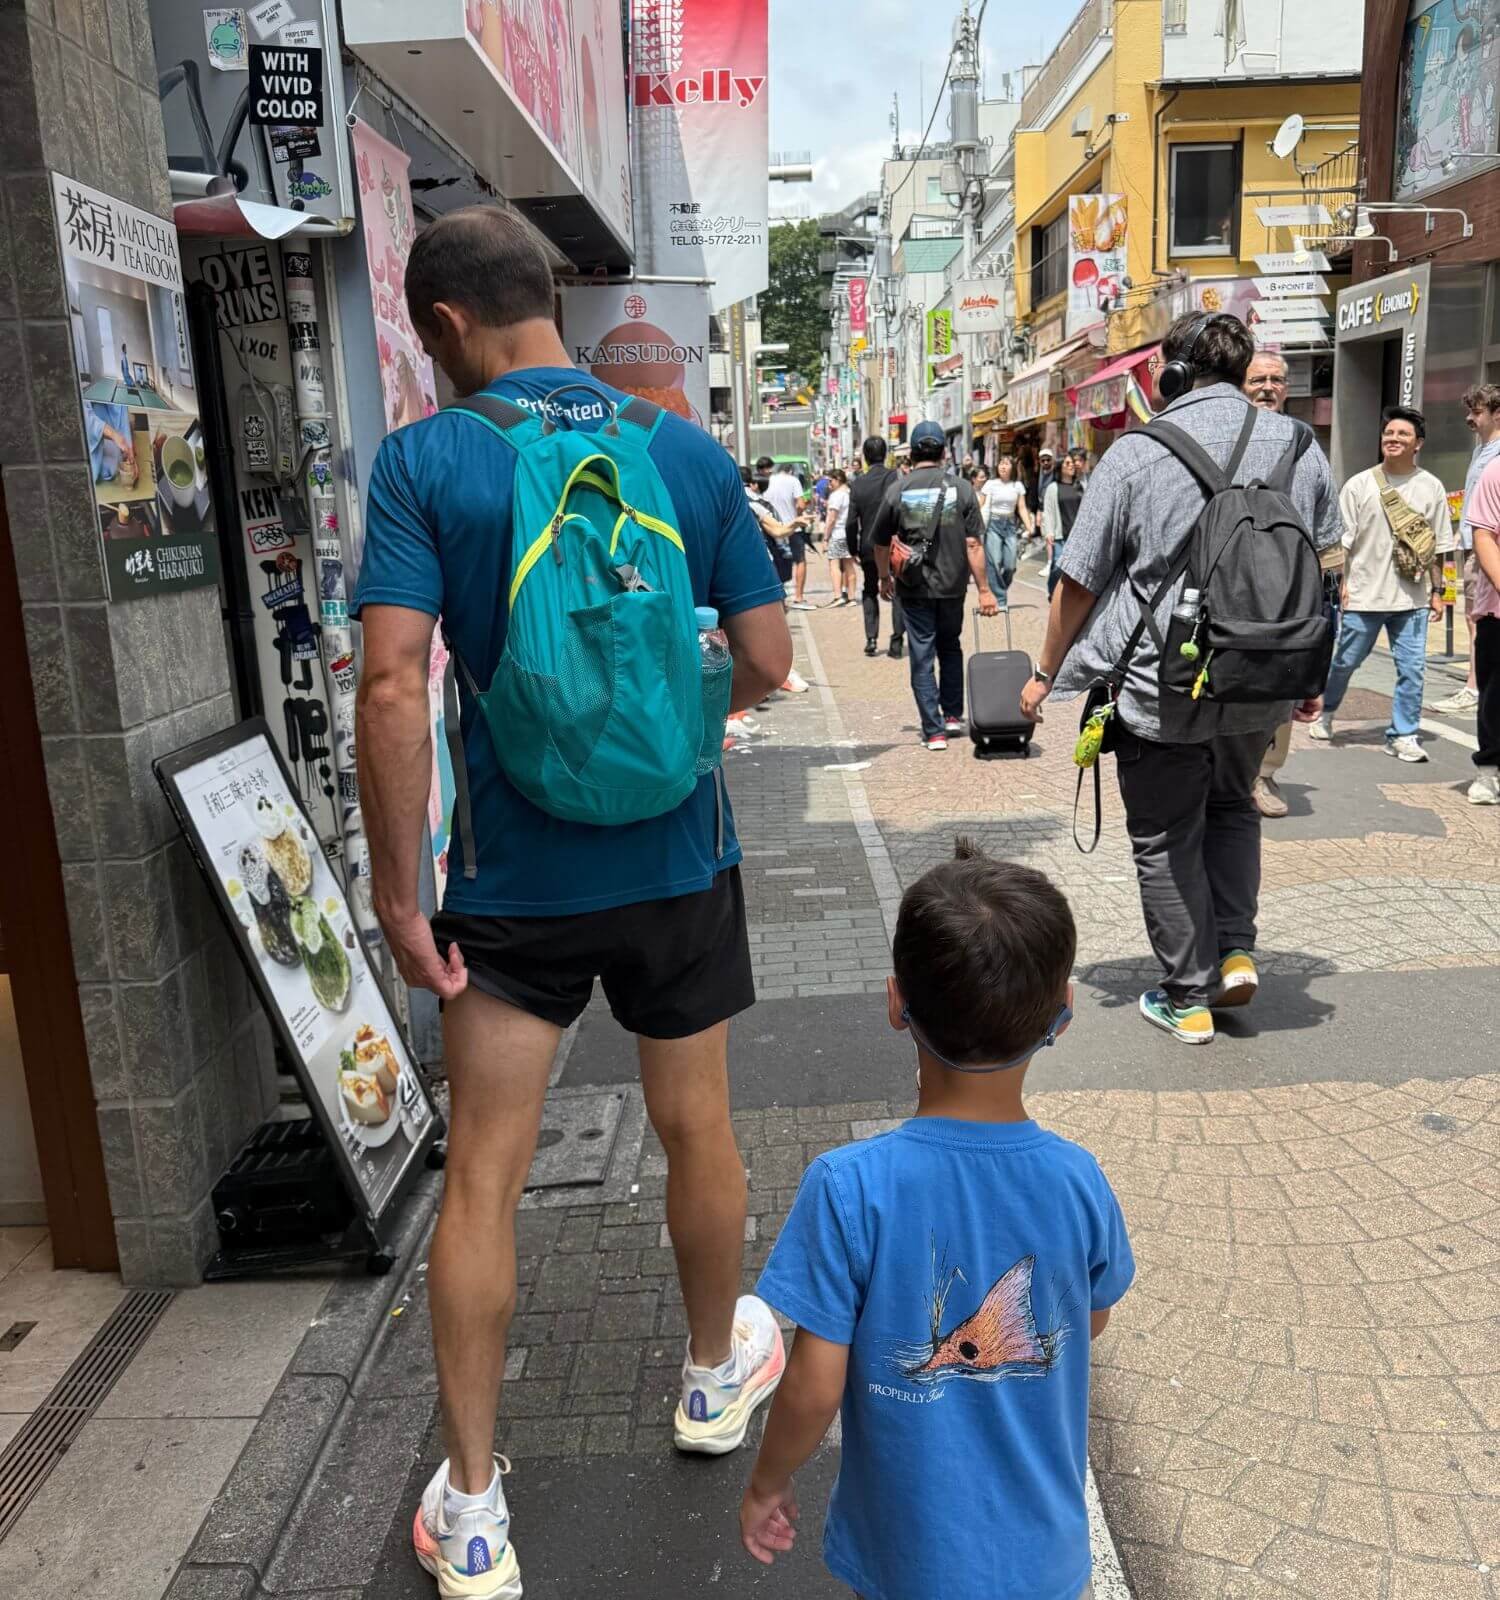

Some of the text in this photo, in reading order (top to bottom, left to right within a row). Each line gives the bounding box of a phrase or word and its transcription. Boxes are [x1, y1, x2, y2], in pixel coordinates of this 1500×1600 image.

[261, 52, 309, 73] WITH
[261, 75, 313, 95] VIVID
[634, 68, 766, 108] Kelly
[256, 99, 317, 119] COLOR
[669, 203, 701, 214] 不動産
[60, 186, 116, 262] 茶房
[117, 211, 177, 259] MATCHA
[120, 243, 180, 285] TEA ROOM
[1338, 291, 1412, 331] CAFE LEMONICA
[576, 345, 705, 364] KATSUDON
[1403, 332, 1416, 407] UNI DON
[156, 544, 203, 563] CHIKUSUIAN
[158, 559, 204, 580] HARAJUKU
[868, 1383, 925, 1403] PROPERLY
